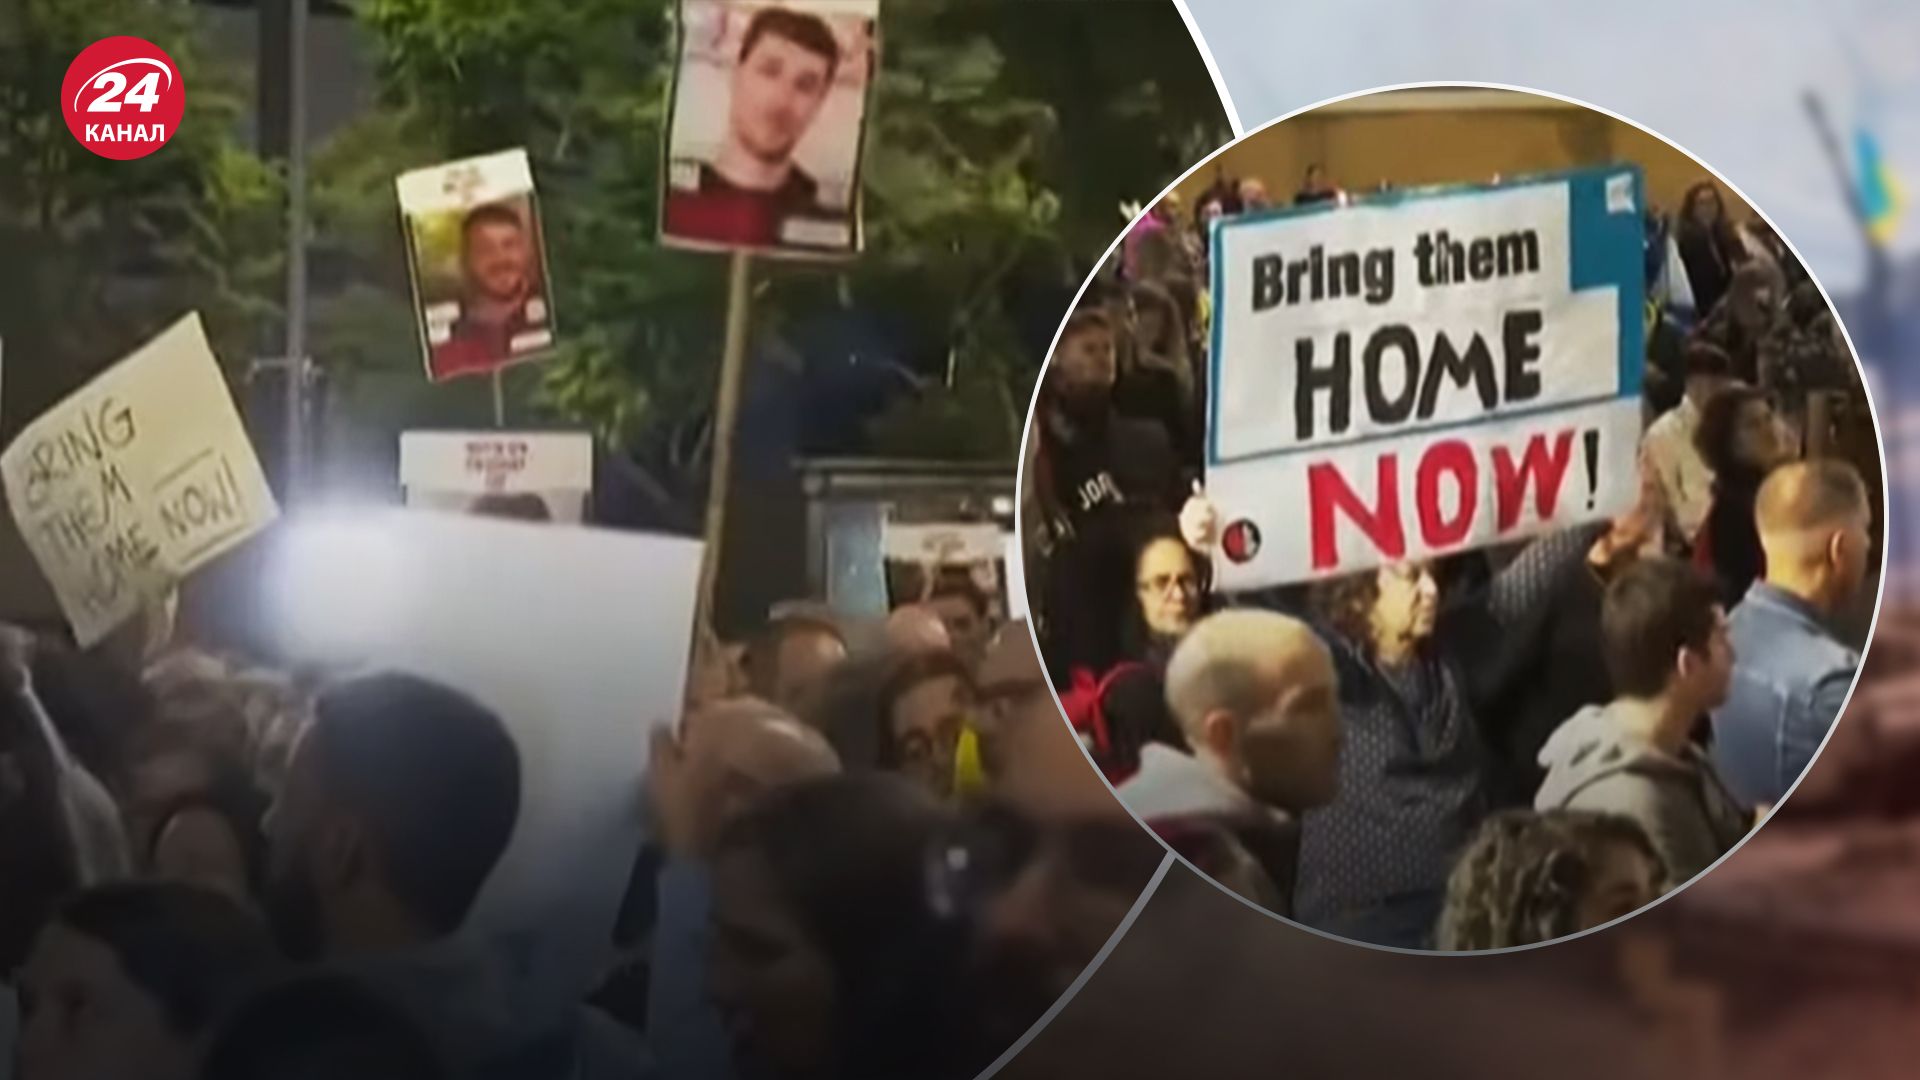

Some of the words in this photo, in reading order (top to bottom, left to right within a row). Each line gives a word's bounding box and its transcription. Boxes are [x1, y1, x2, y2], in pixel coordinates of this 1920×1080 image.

[1252, 243, 1395, 312] Bring
[1413, 229, 1539, 288] them
[1294, 309, 1543, 442] HOME
[41, 464, 132, 566] THEM
[1308, 428, 1600, 572] NOW!
